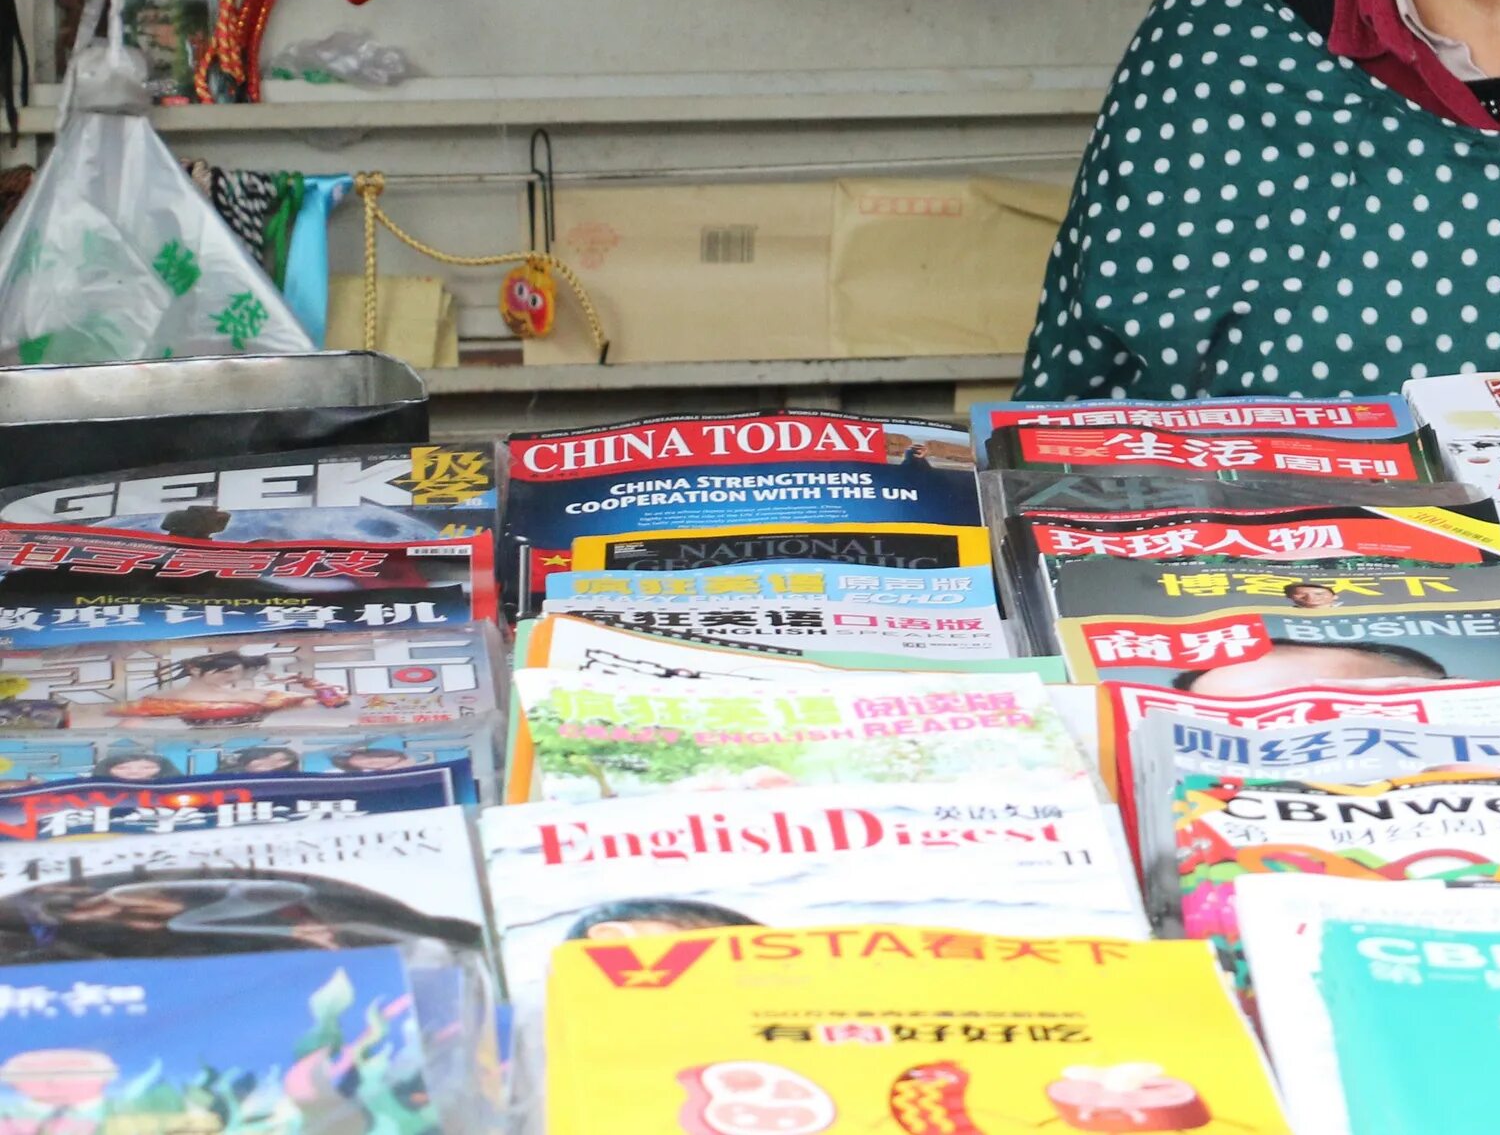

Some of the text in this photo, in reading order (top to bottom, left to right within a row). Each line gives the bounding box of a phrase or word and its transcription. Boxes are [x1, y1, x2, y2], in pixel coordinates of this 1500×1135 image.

[523, 421, 880, 474] CHINA TODAY
[1, 460, 414, 524] GEEK
[609, 472, 873, 495] CHINA STRENGTHENS
[564, 486, 918, 515] COOPERATION WITH THE UN
[679, 536, 896, 559] NATIONAL
[1048, 523, 1344, 558] 环球人物
[572, 572, 973, 597] 疯狂英语 原声版
[1159, 570, 1459, 598] 博客天下
[75, 595, 313, 608] MicroComputer
[833, 614, 985, 632] 口语版
[1088, 626, 1264, 664] 商界
[551, 687, 1022, 726] 疯狂英语 阅读版
[694, 727, 855, 745] ENGLISH
[862, 714, 1036, 740] READER
[750, 1022, 1096, 1046] 有肉好好吃
